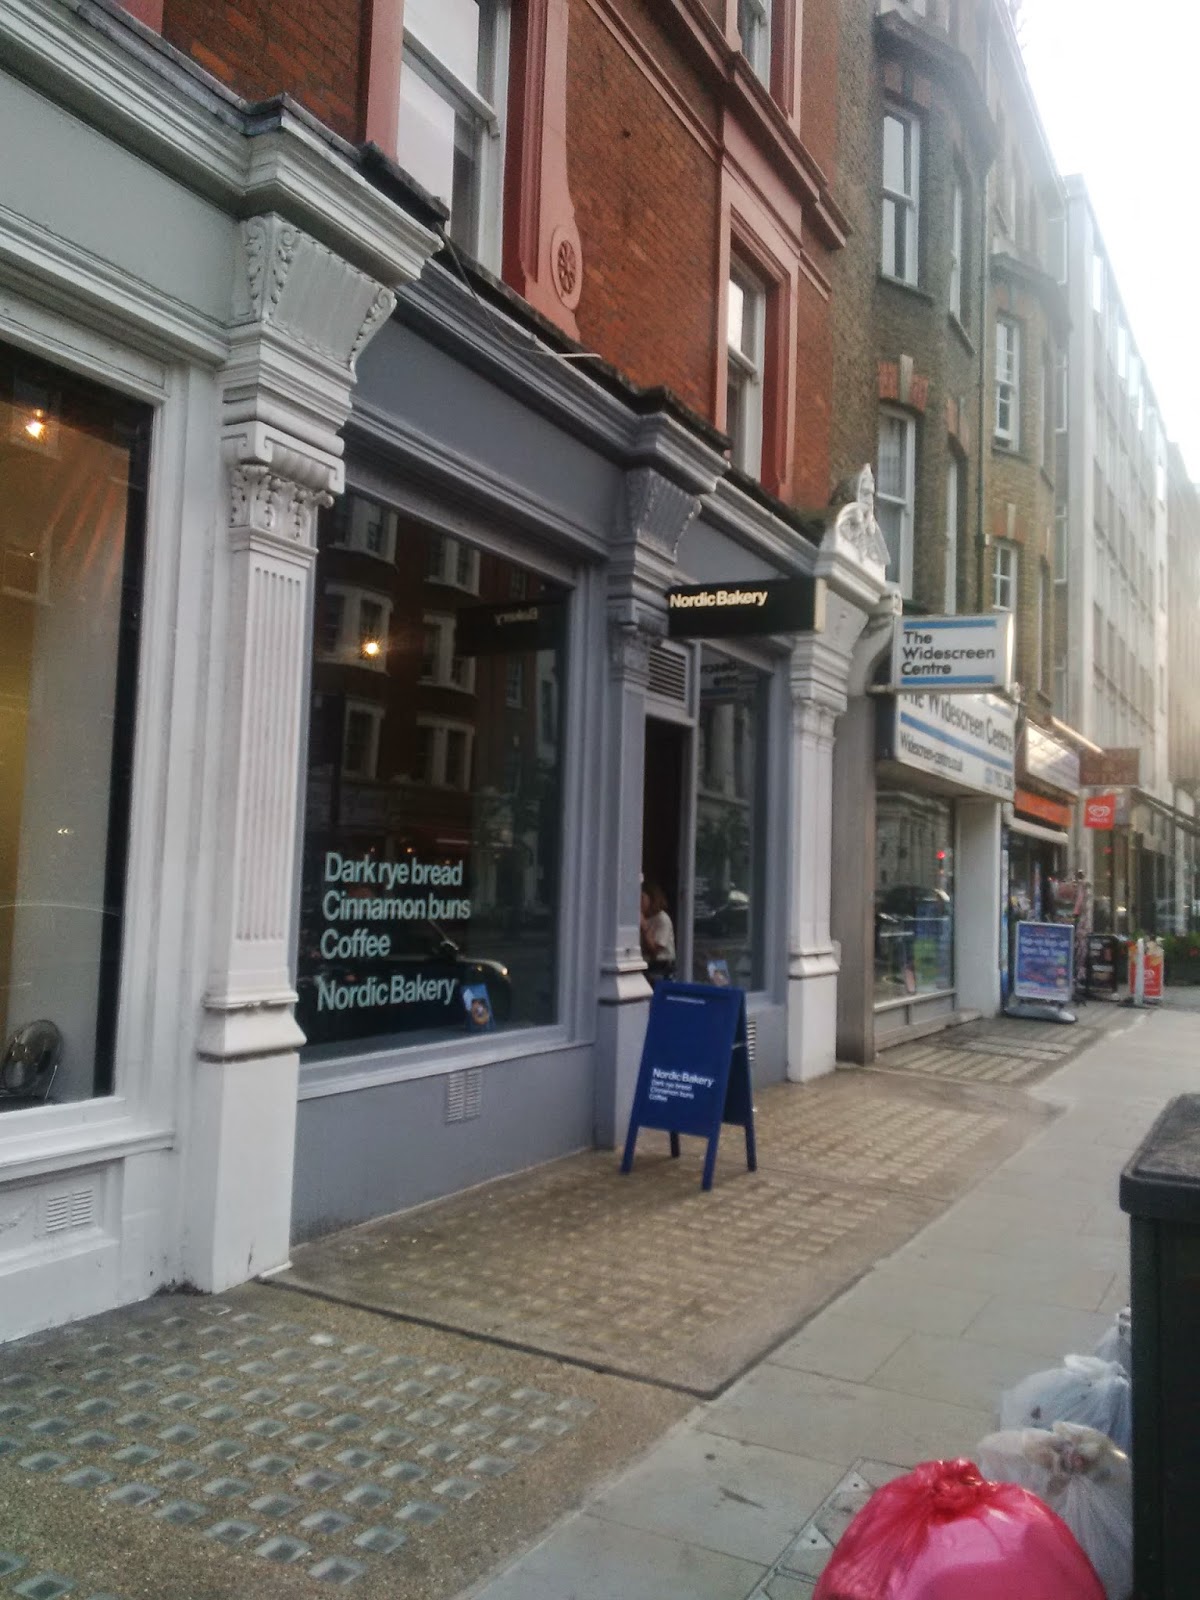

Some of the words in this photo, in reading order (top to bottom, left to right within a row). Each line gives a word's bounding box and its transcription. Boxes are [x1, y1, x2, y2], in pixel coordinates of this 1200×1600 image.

[669, 591, 716, 608] Nordic
[716, 589, 768, 606] Bakery
[903, 631, 932, 644] The
[902, 647, 995, 661] Widescreen
[901, 660, 951, 676] Centre
[324, 852, 376, 883] Dark
[377, 861, 409, 891] rye
[411, 857, 464, 887] bread
[322, 889, 426, 921] Cinnamon
[428, 893, 472, 920] buns
[320, 928, 391, 960] Coffee
[316, 974, 389, 1012] Nordic
[390, 973, 457, 1005] Bakery
[652, 1068, 681, 1081] Nordic
[682, 1072, 714, 1088] Bakery
